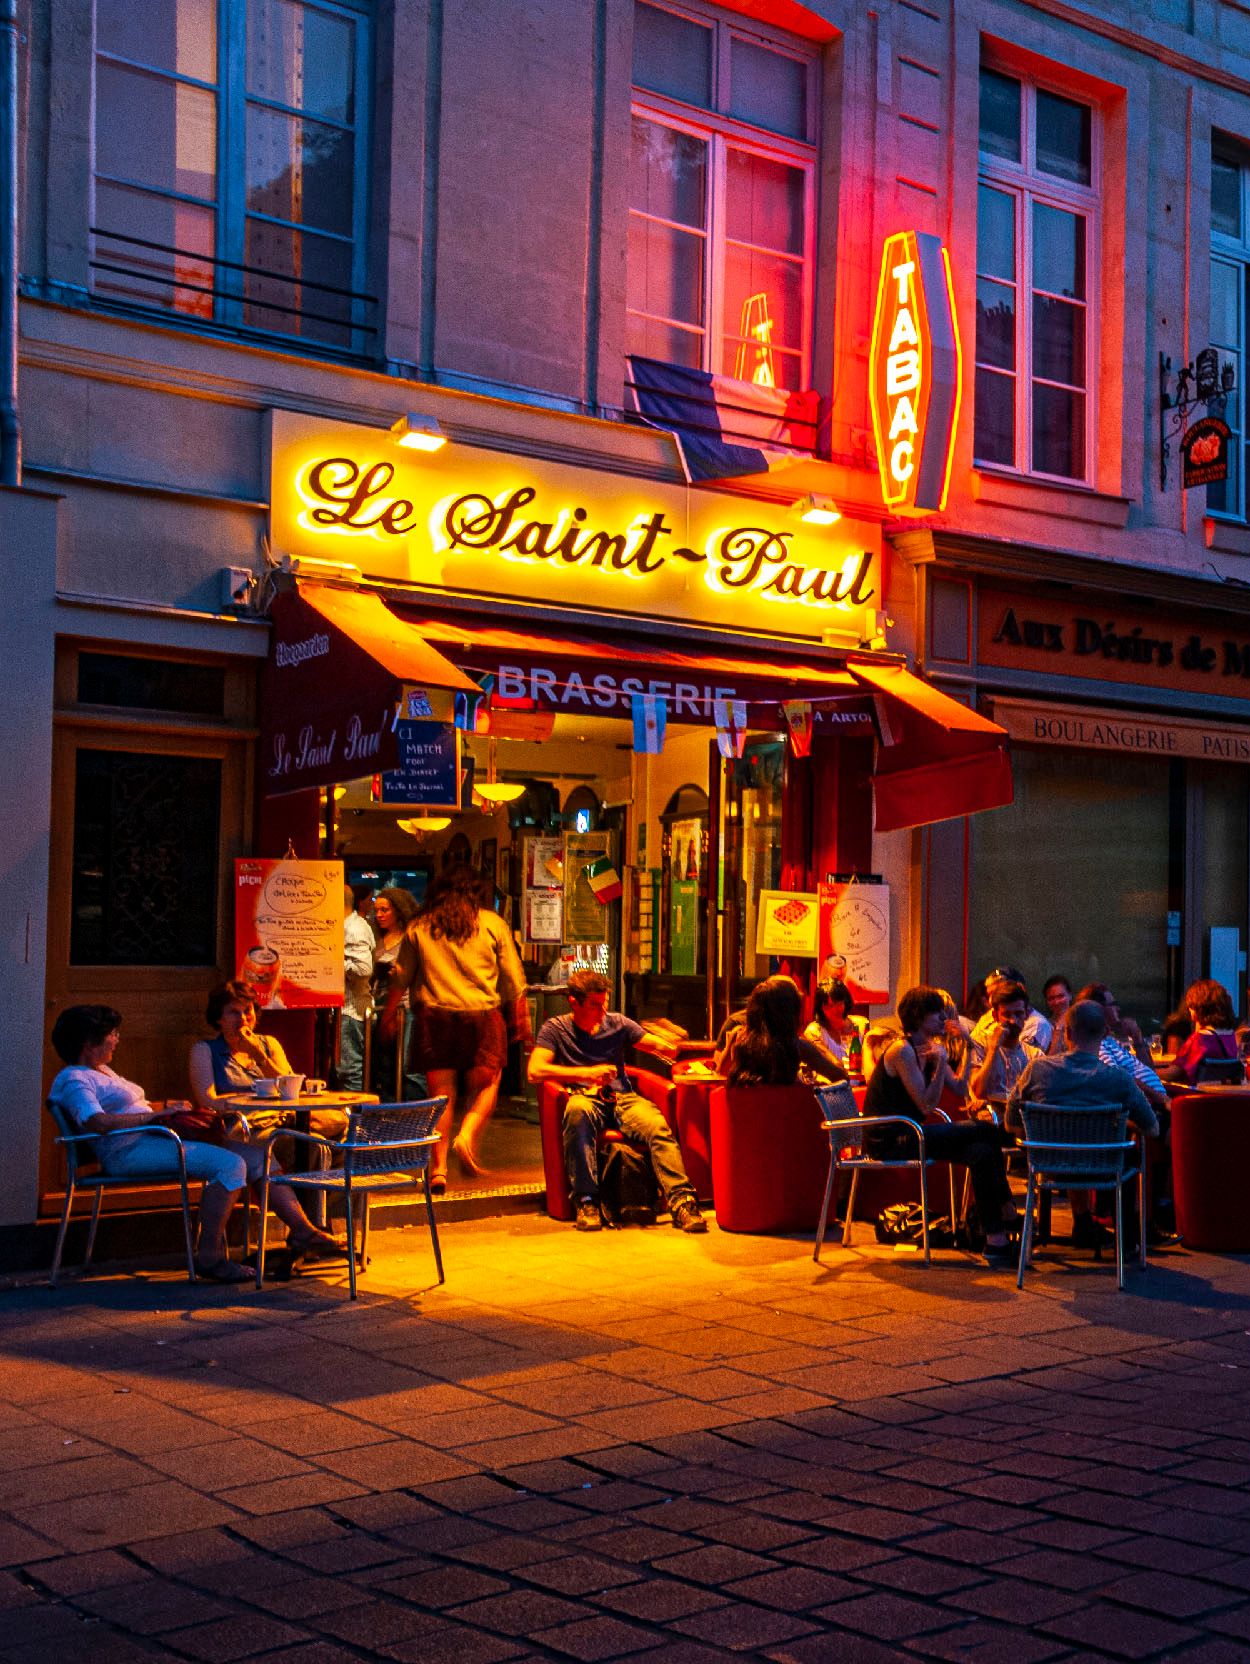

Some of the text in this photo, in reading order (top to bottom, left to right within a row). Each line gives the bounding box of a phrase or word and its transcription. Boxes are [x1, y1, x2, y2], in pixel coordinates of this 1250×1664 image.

[887, 261, 922, 483] TABAC
[308, 457, 417, 535] Le
[991, 606, 1064, 653] Aux
[1074, 617, 1174, 666] Désirs
[1179, 635, 1216, 671] de
[268, 709, 389, 776] Le Saint Paul
[1033, 717, 1177, 752] BOULANGERIE
